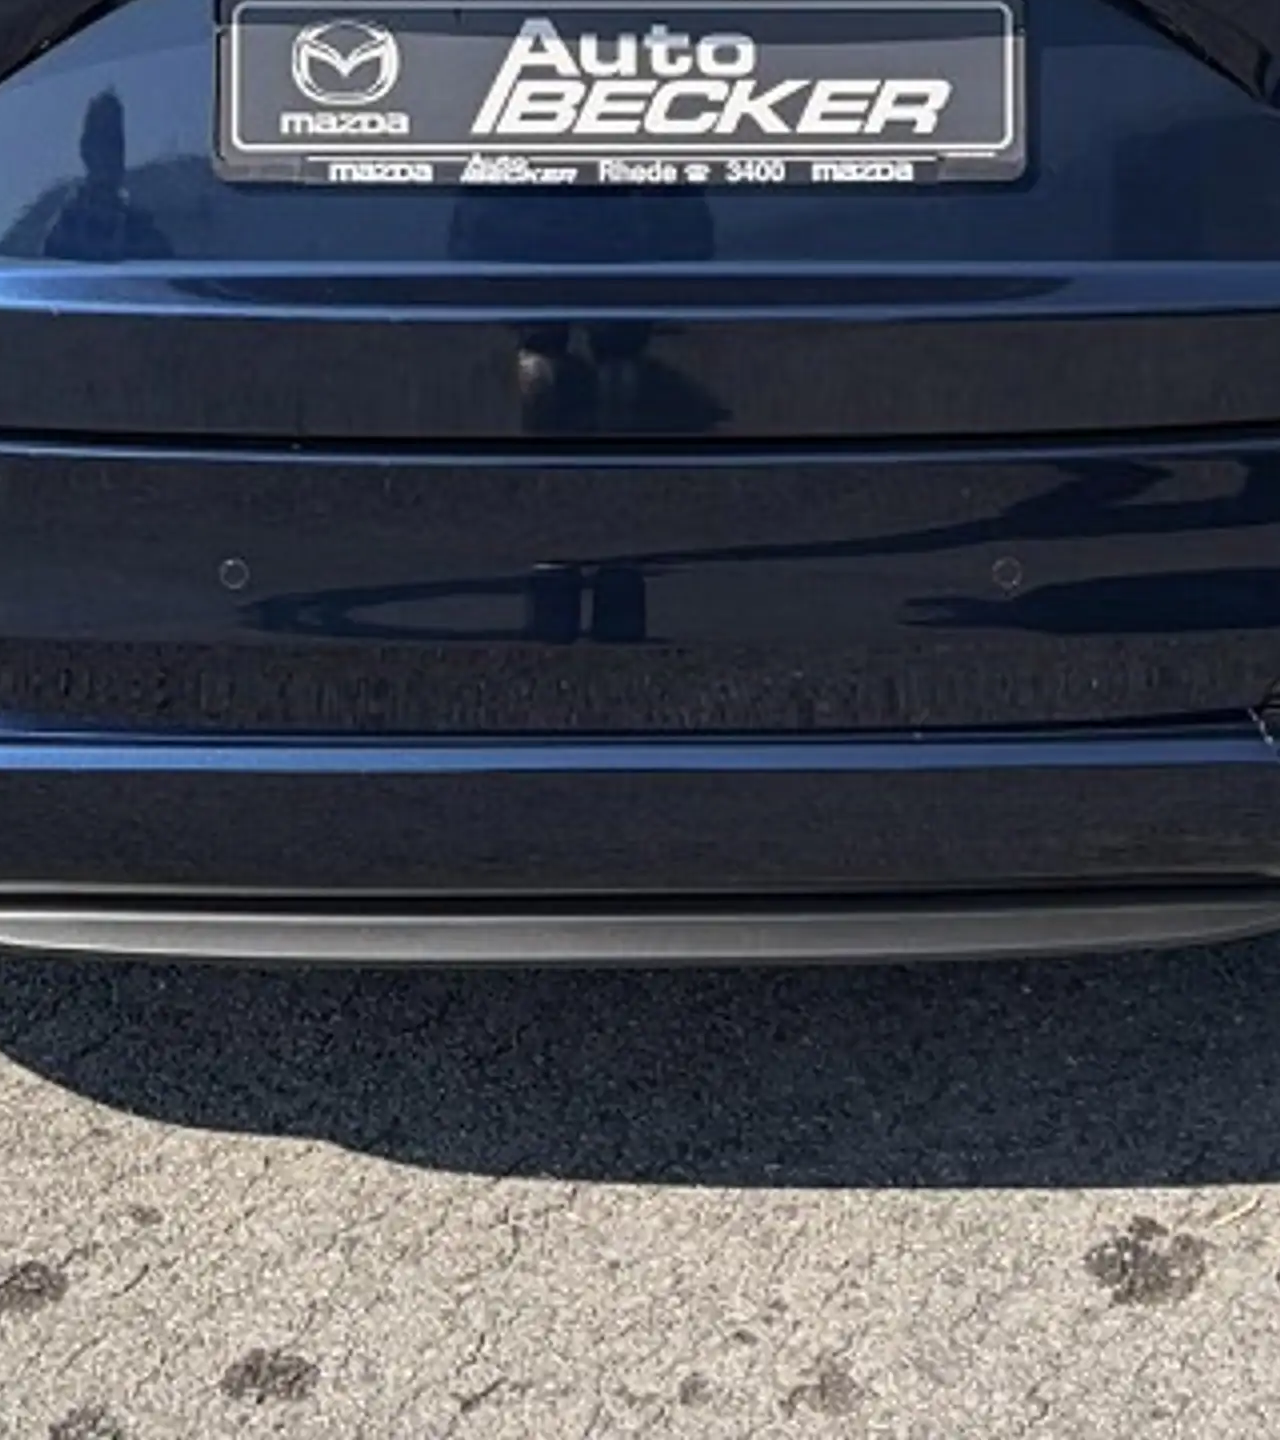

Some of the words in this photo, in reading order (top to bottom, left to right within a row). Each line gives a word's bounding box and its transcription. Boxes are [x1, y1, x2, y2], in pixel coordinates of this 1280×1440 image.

[492, 17, 756, 78] Auto
[476, 79, 951, 134] BECKER
[598, 160, 677, 183] Rhede
[724, 160, 786, 183] 3400
